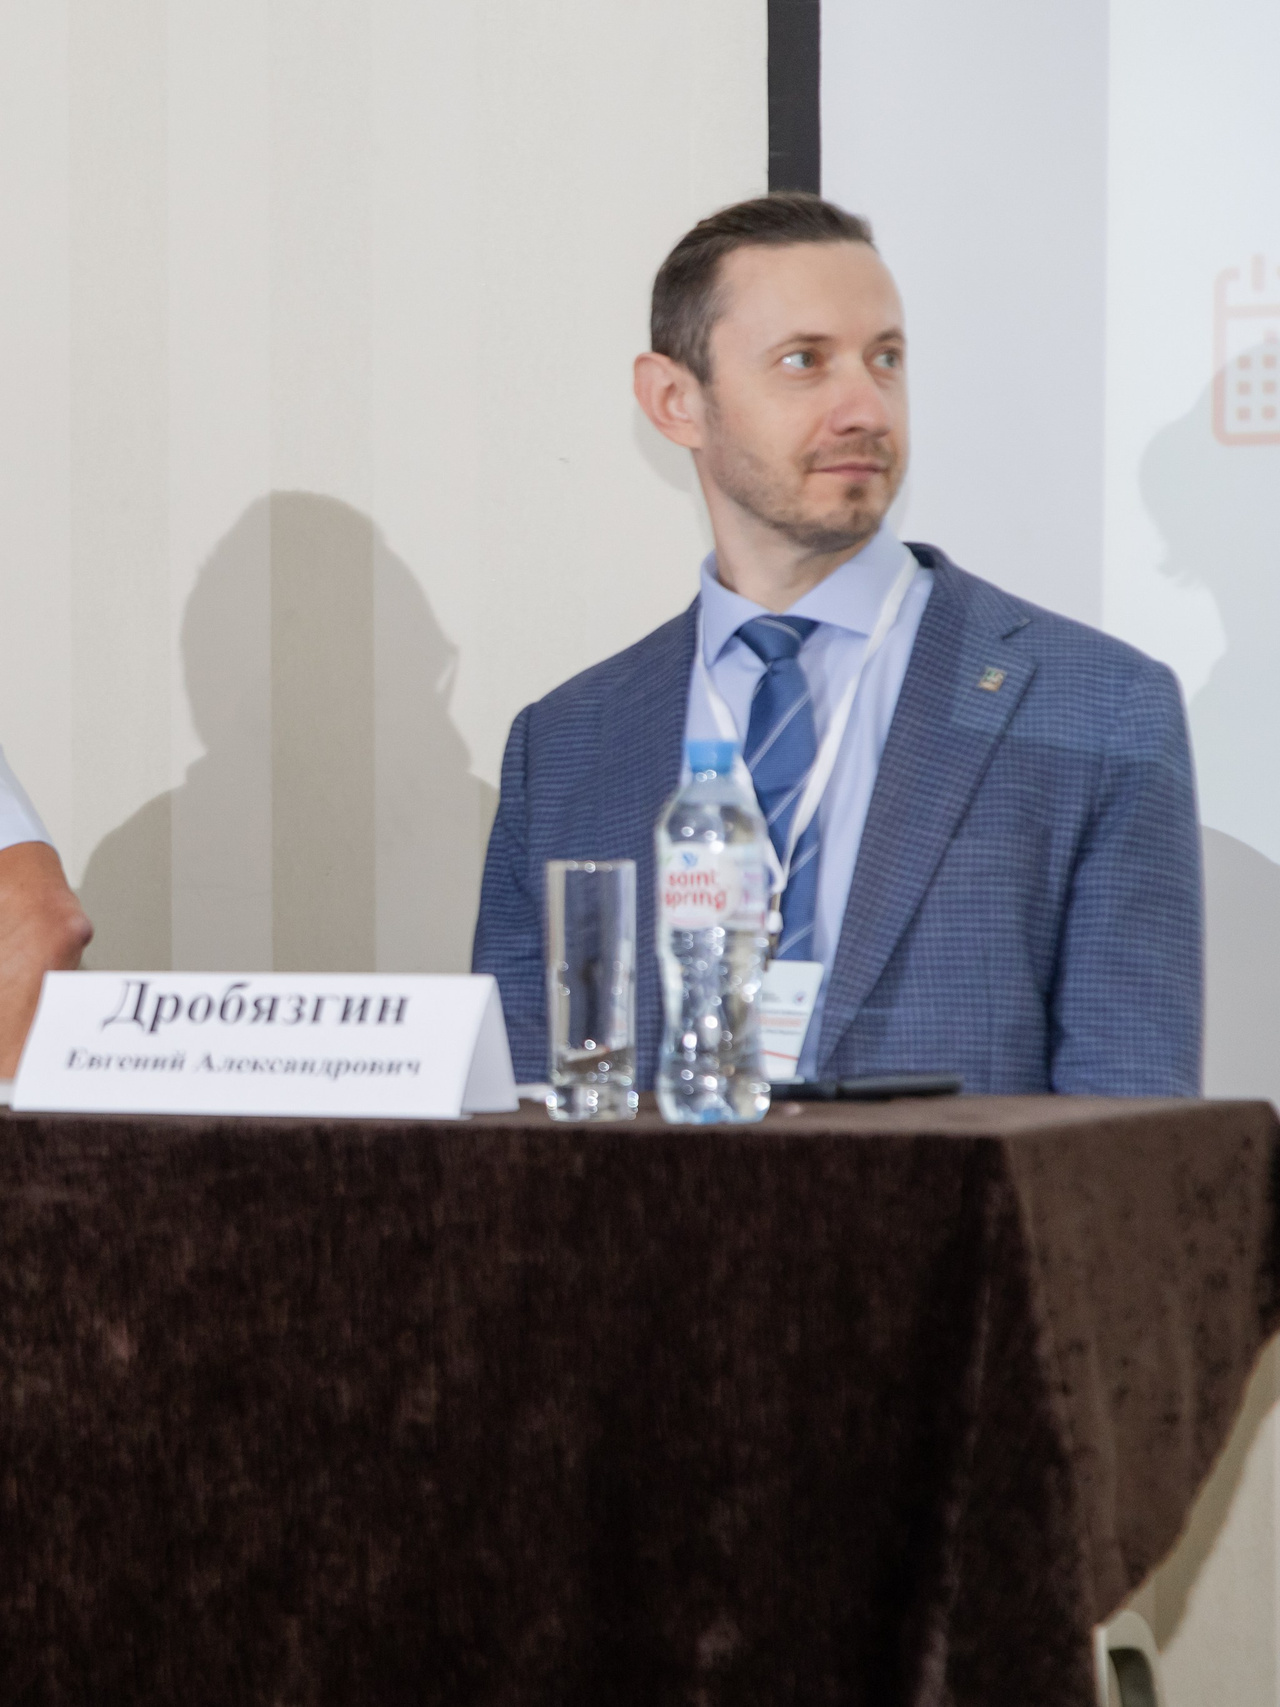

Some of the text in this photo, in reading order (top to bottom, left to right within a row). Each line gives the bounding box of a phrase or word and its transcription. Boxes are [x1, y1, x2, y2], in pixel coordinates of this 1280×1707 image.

[101, 979, 412, 1034] Дробязгин
[66, 1047, 422, 1081] Евгений Александрович
